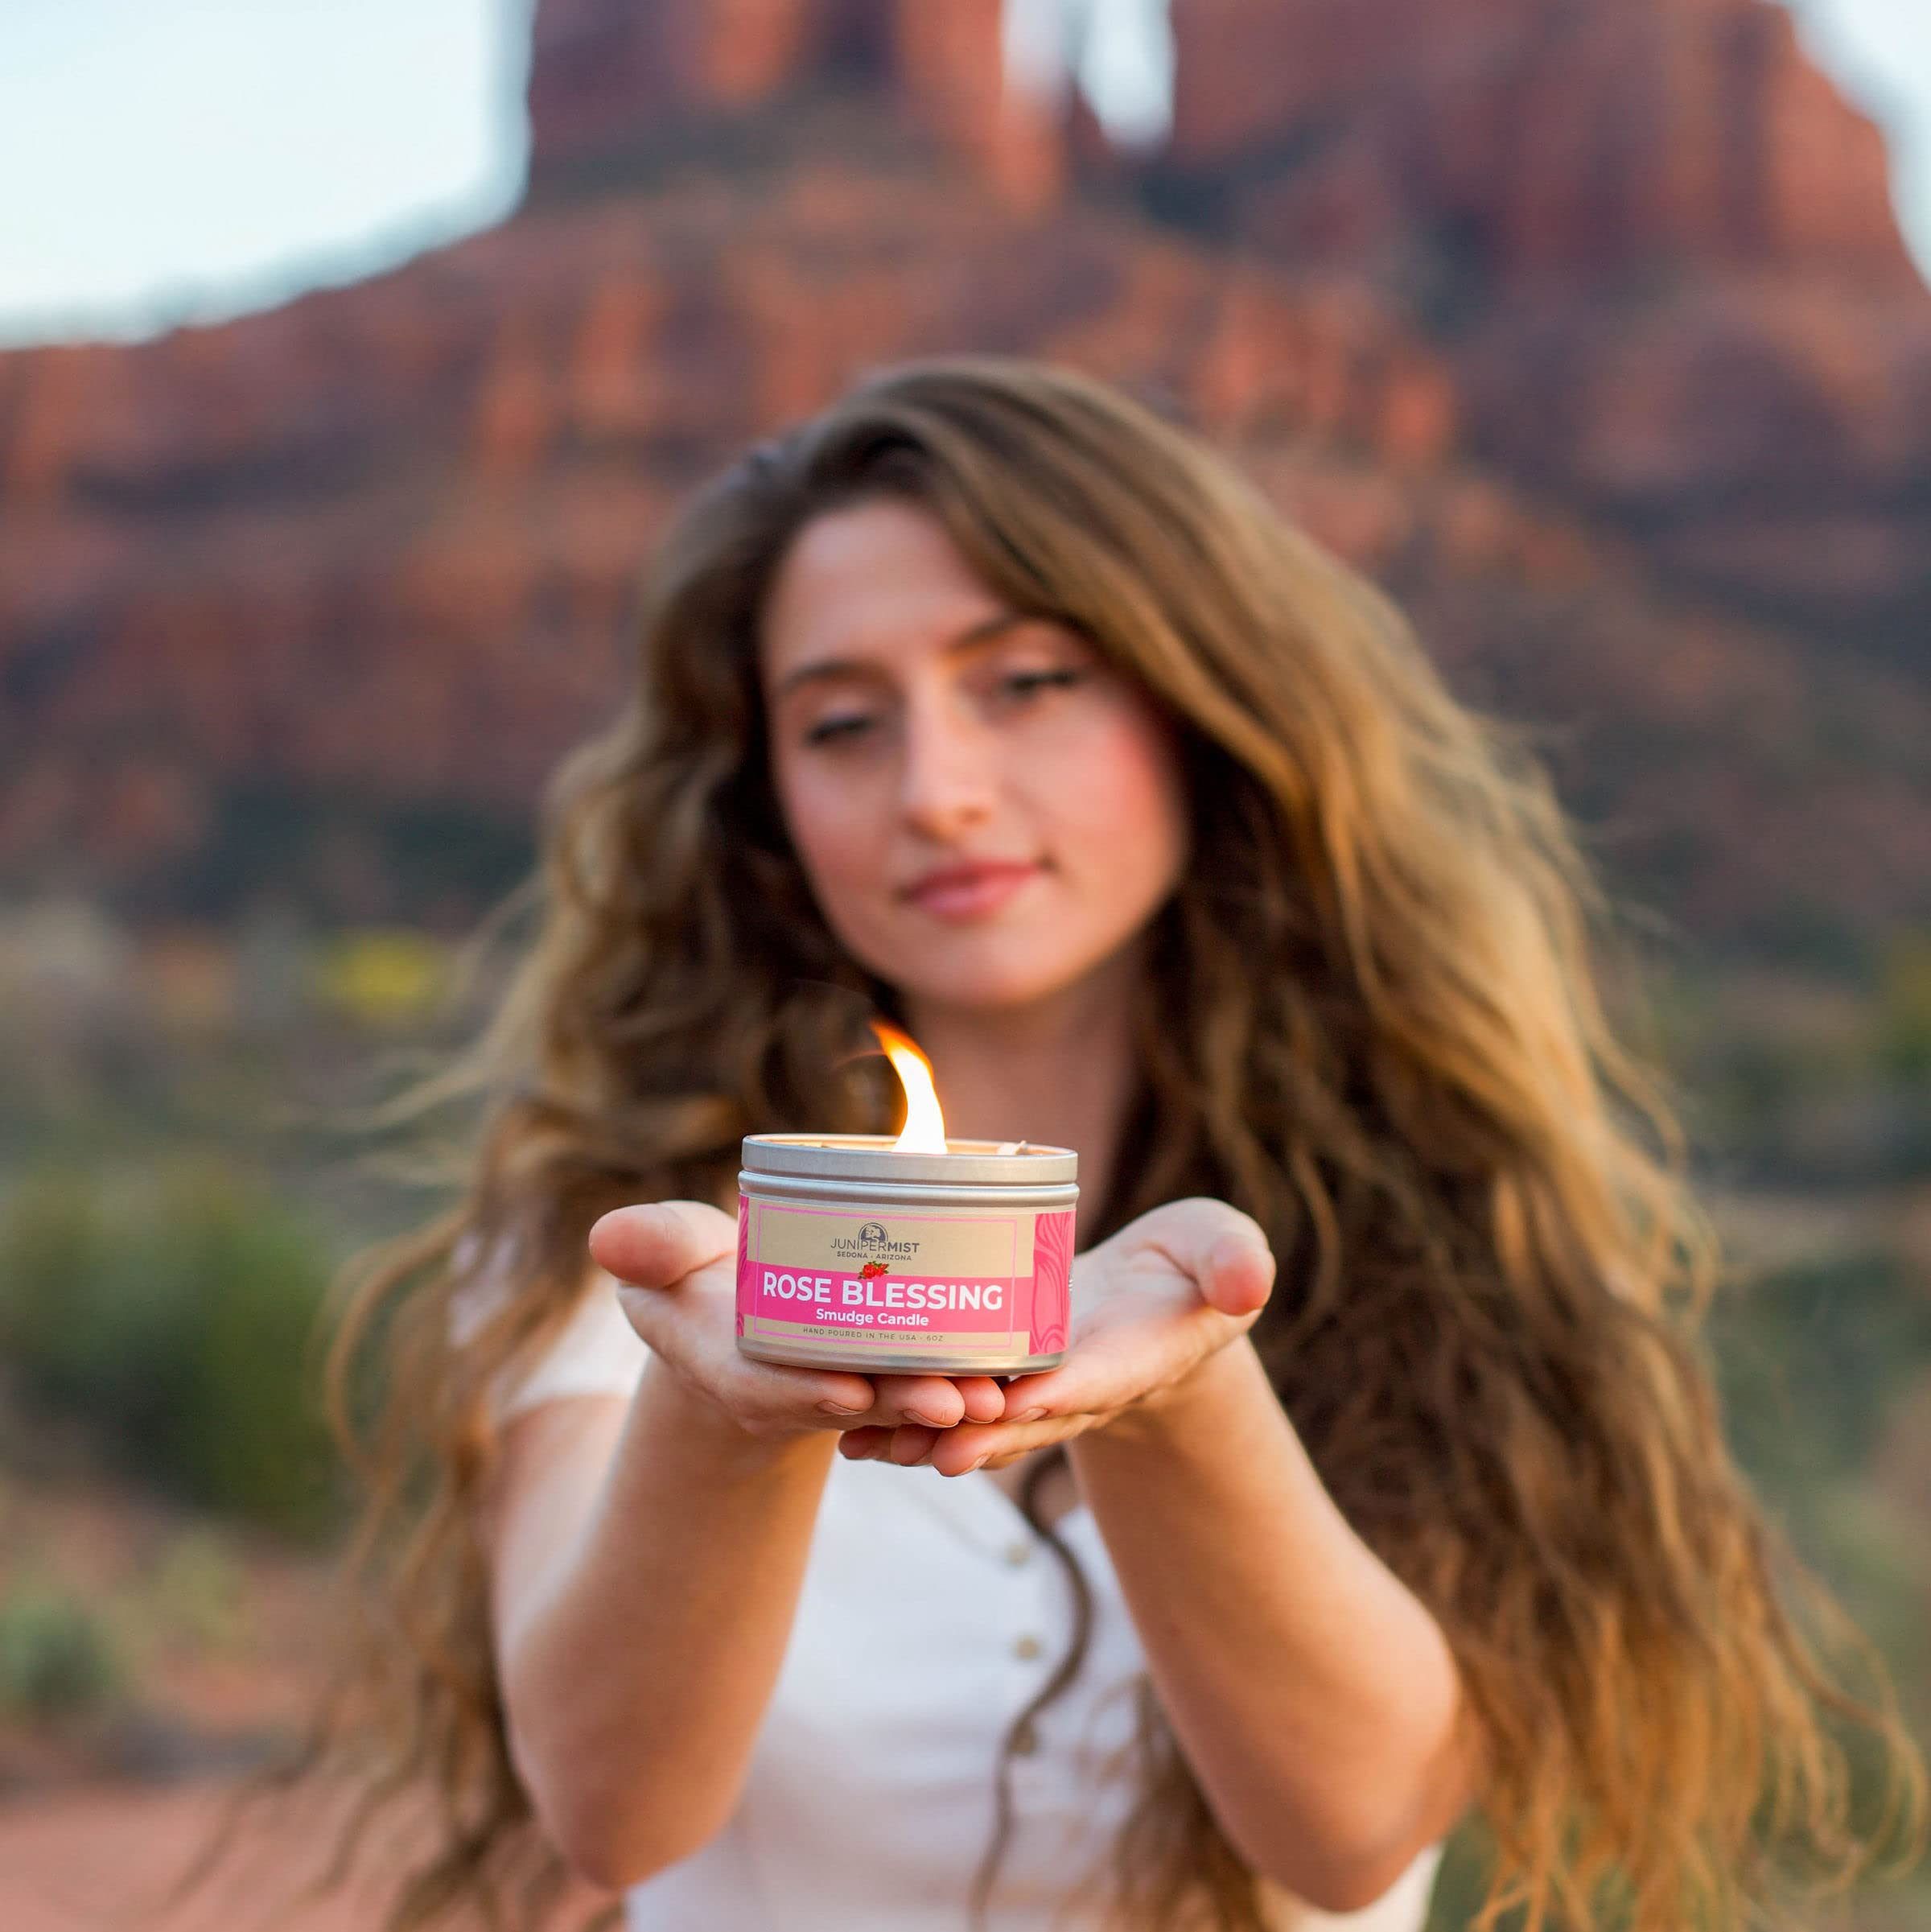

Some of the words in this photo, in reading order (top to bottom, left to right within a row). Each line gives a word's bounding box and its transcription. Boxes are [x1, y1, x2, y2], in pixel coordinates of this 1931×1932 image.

[830, 1238, 920, 1253] JUNIPERMIST
[837, 1250, 868, 1258] SEDONA
[763, 1271, 832, 1303] ROSE
[842, 1280, 1003, 1310] BLESSING
[816, 1308, 874, 1325] Smudge
[877, 1312, 929, 1325] Candle
[828, 1329, 862, 1338] POURED
